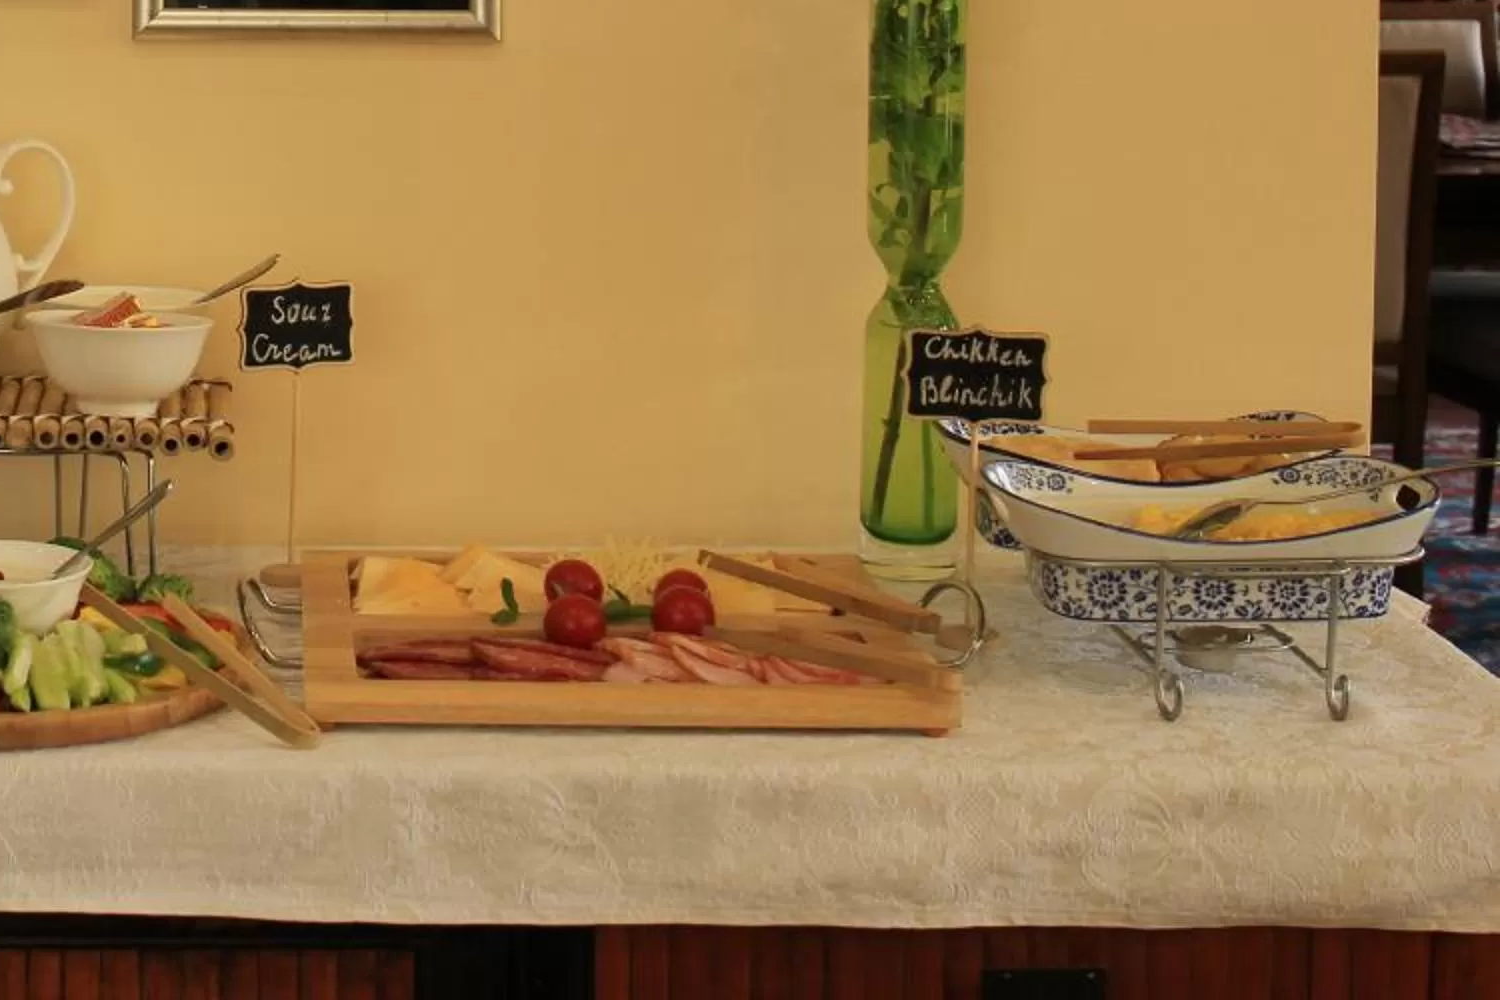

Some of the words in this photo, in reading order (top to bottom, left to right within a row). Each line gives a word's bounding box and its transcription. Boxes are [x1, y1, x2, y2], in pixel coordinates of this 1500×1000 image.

[271, 295, 332, 325] Sour
[251, 332, 342, 363] Cream
[919, 373, 1034, 409] Blinchik
